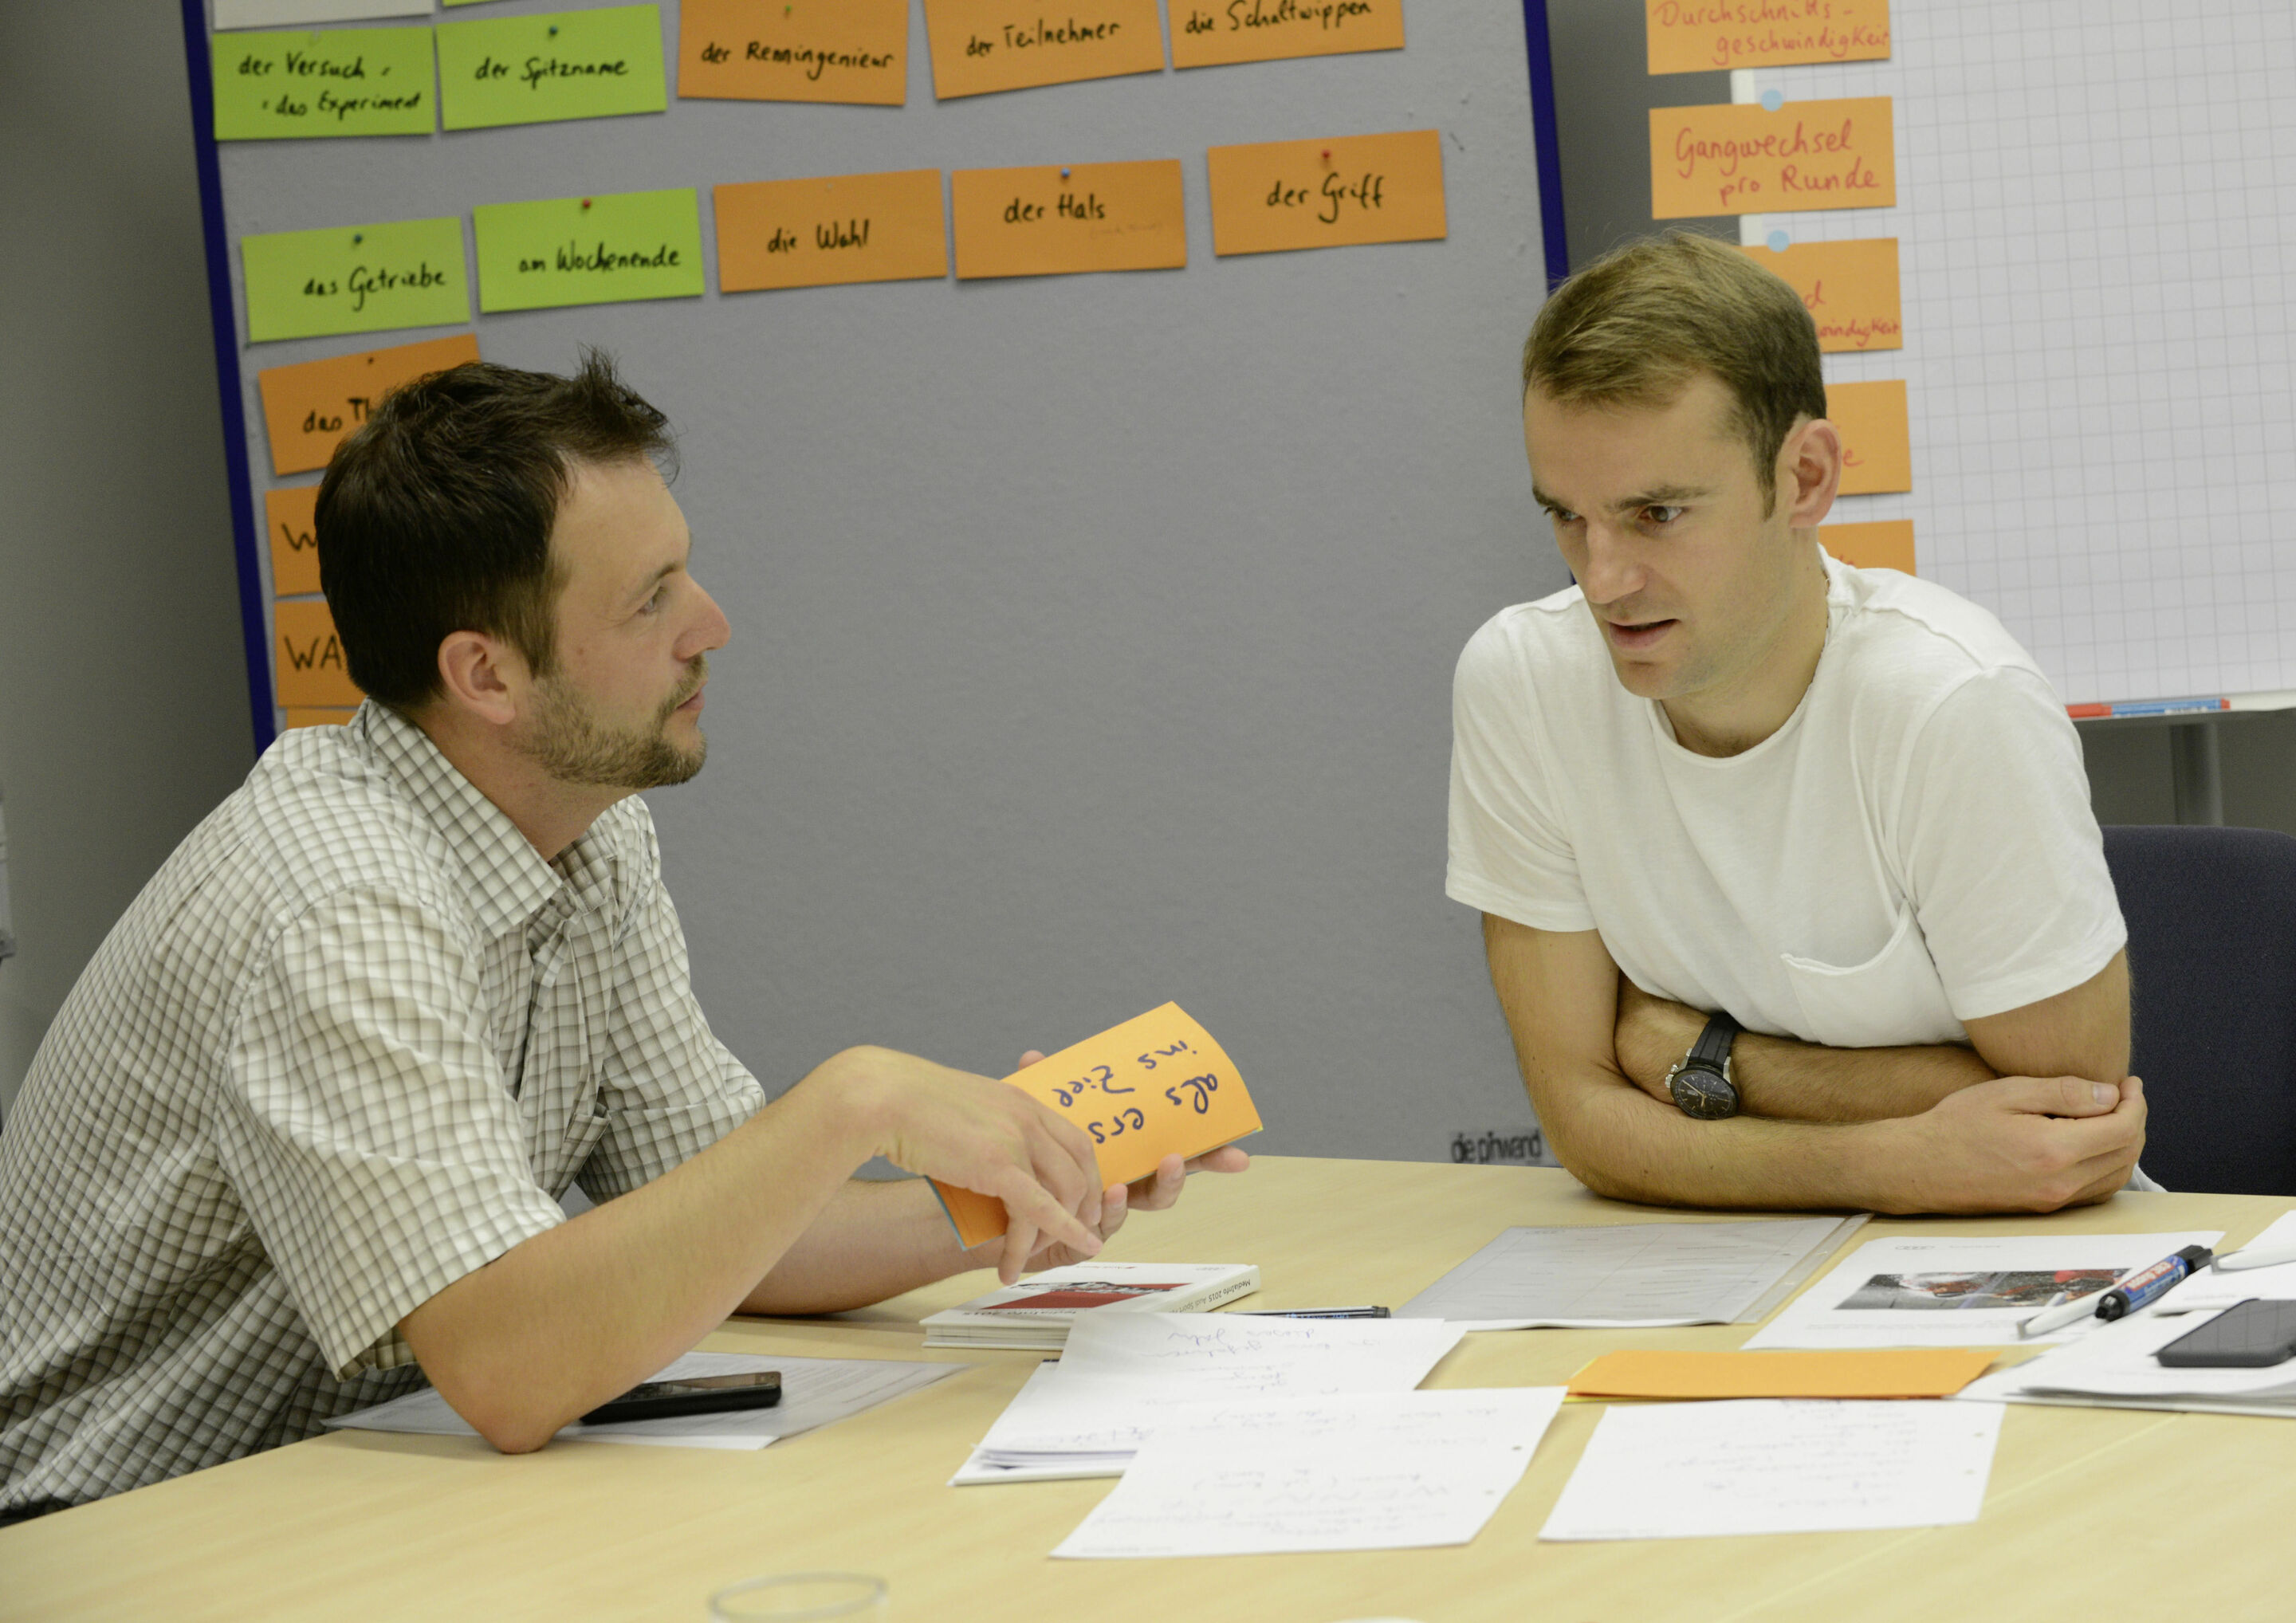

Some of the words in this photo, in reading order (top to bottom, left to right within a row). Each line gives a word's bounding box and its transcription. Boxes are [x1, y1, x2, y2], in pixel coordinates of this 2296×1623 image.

[1185, 10, 1216, 33] die
[1227, 0, 1372, 30] Schaltwippen
[702, 41, 731, 64] der
[966, 34, 994, 57] der
[1003, 18, 1121, 48] Teilnehmer
[238, 54, 273, 76] der
[286, 51, 365, 78] Versuch
[474, 57, 509, 80] der
[521, 56, 628, 90] Spitzname
[275, 94, 308, 116] das
[317, 89, 421, 120] Experiment
[1676, 118, 1853, 179] Gangwechsel
[1266, 180, 1310, 207] der
[1318, 172, 1385, 224] Griff
[1719, 177, 1761, 207] pro
[1782, 156, 1881, 192] Runde
[1004, 197, 1045, 223] der
[1057, 193, 1106, 220] Hals
[767, 227, 796, 253] die
[816, 218, 870, 250] Wahl
[519, 258, 546, 273] am
[556, 239, 682, 272] Wochenende
[303, 278, 338, 296] das
[348, 261, 447, 312] Getriebe
[302, 409, 343, 433] das
[1137, 1040, 1197, 1069] ins
[1052, 1065, 1135, 1108] Ziel
[1166, 1073, 1218, 1114] als
[1087, 1107, 1144, 1143] ers
[1208, 1291, 1222, 1302] 2015
